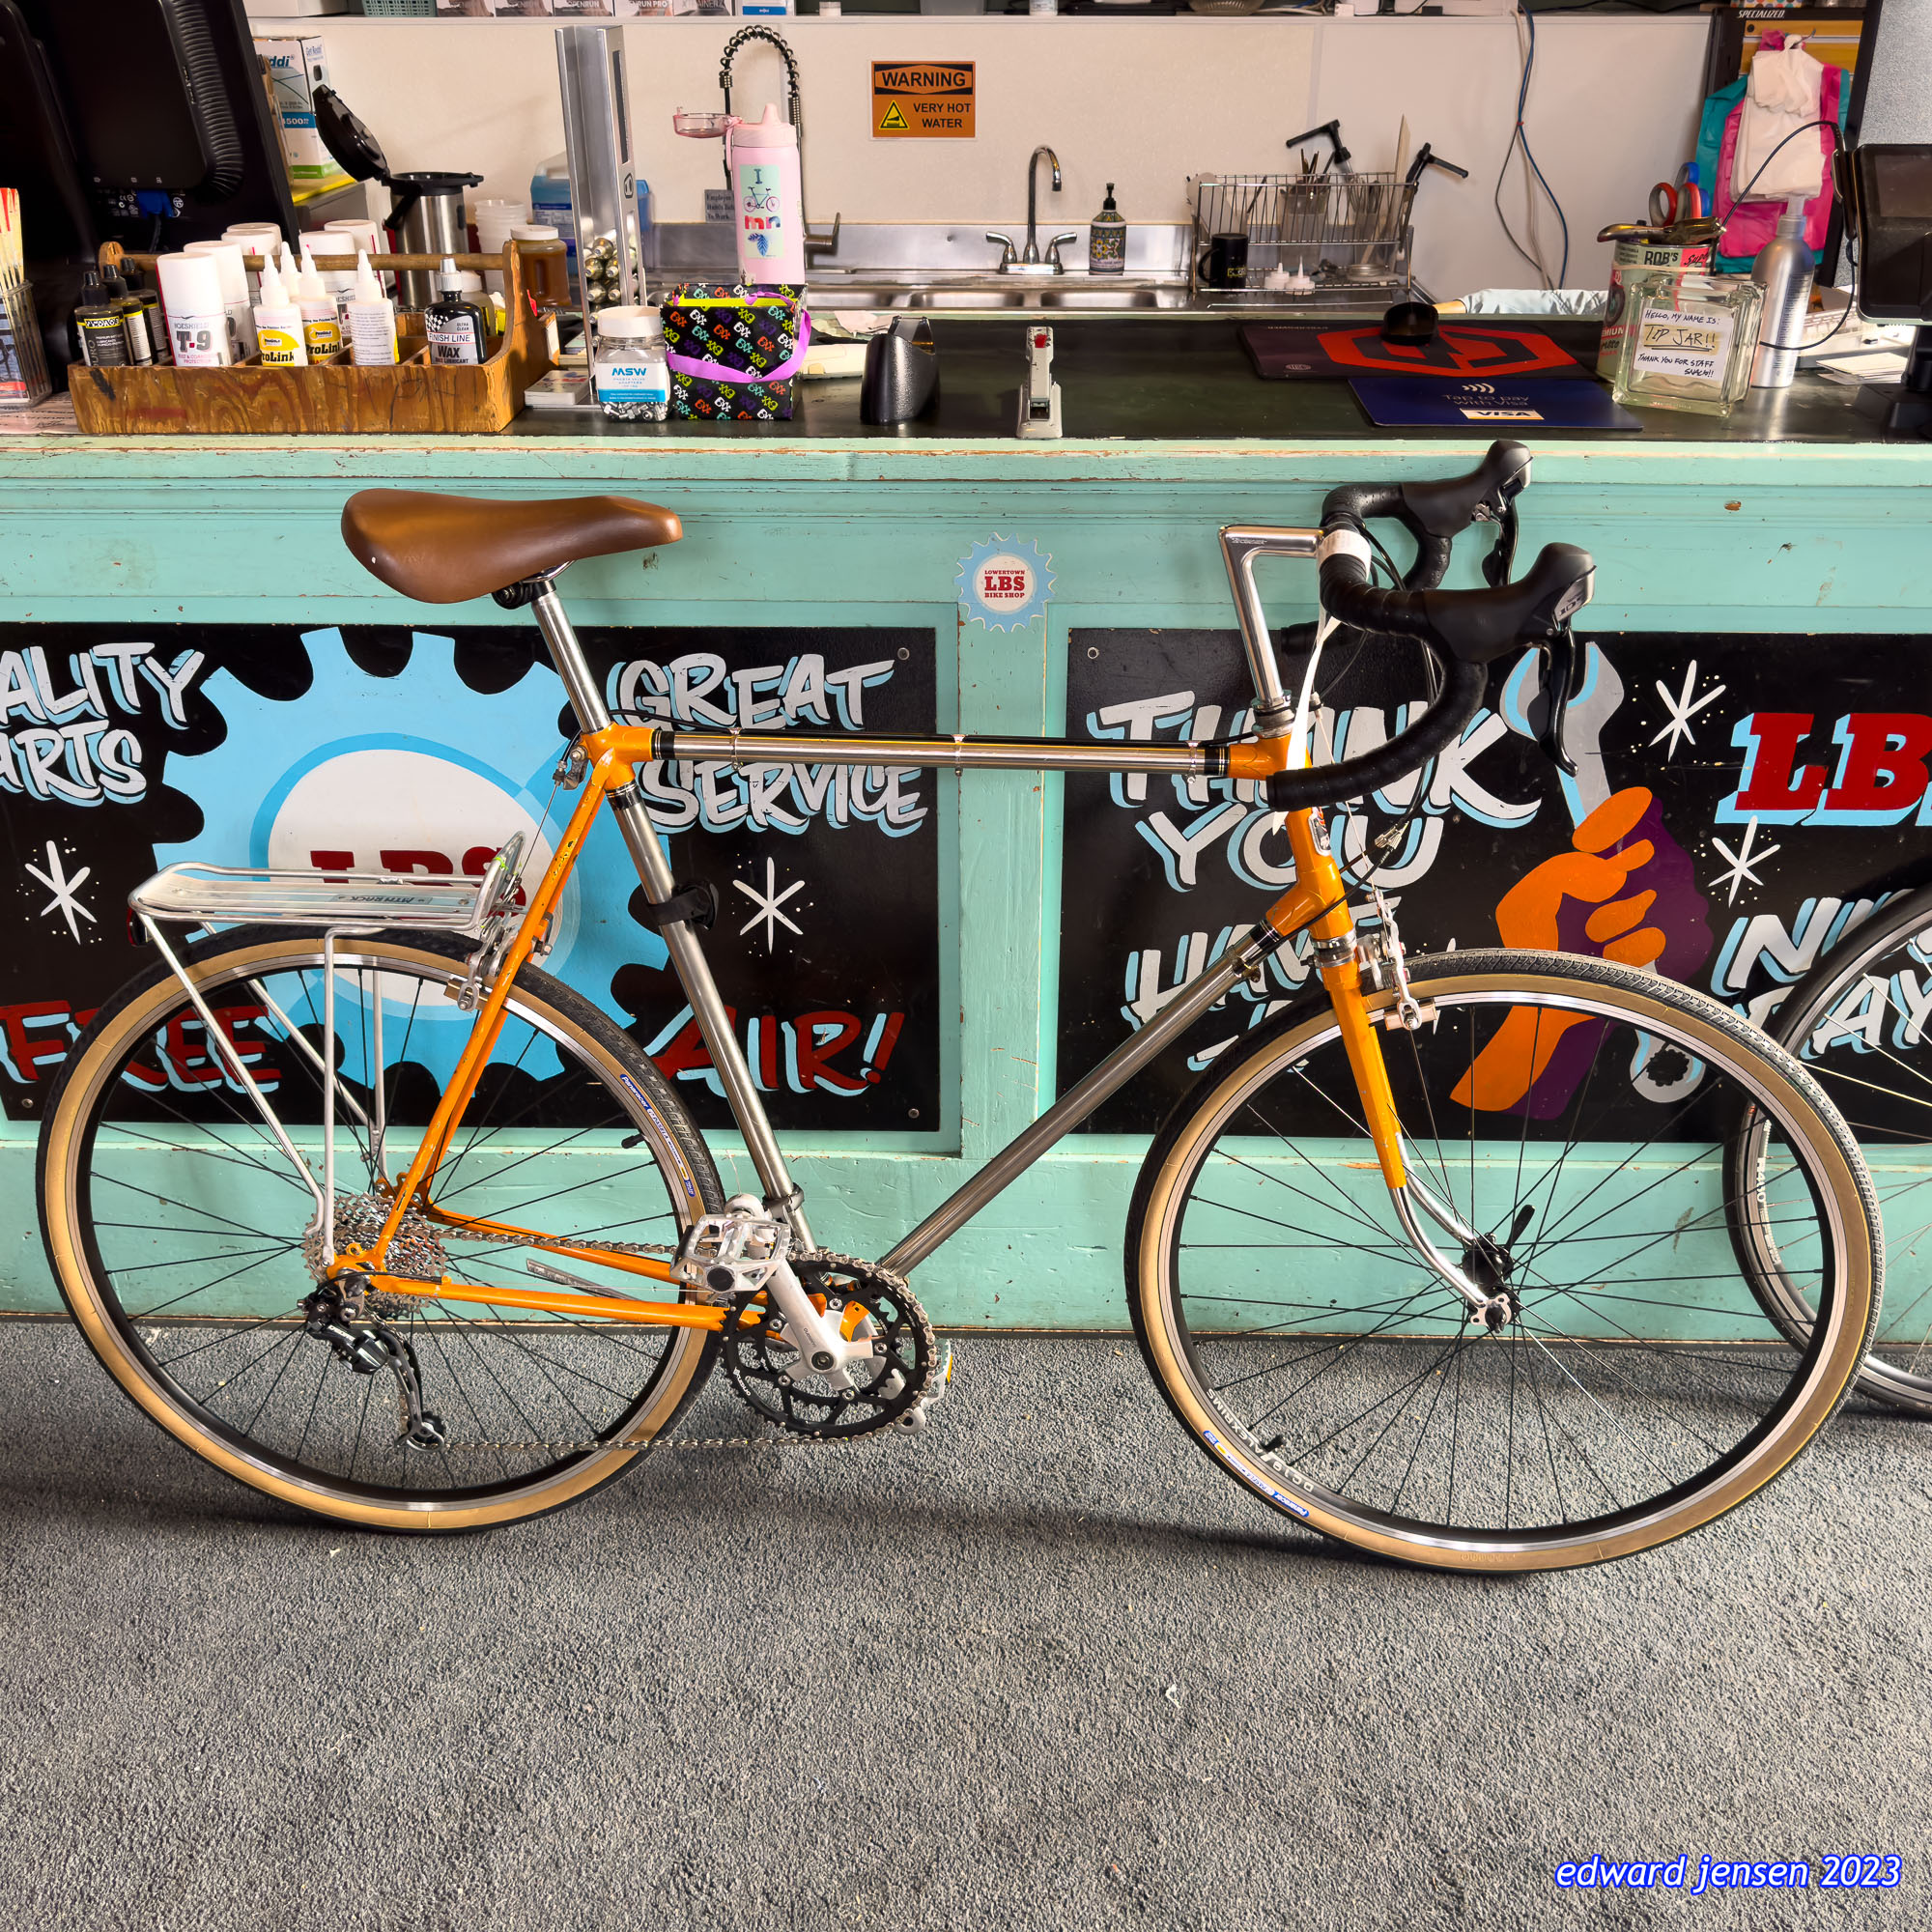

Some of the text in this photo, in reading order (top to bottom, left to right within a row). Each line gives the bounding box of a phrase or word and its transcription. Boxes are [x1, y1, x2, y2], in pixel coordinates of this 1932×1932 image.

[882, 71, 966, 87] WARNING
[913, 102, 971, 113] VERY HOT
[922, 118, 963, 128] WATER
[1670, 312, 1682, 323] MY
[1683, 315, 1704, 324] NAME
[429, 332, 450, 342] FINISH
[1644, 324, 1670, 342] TIP
[438, 345, 461, 358] WAX
[1637, 353, 1660, 363] THANK
[1661, 355, 1673, 364] YOU
[1690, 359, 1715, 368] STAFF
[611, 367, 647, 377] MSW
[984, 576, 1025, 591] LBS
[611, 652, 895, 731] GREAT
[1719, 713, 1932, 823] LB
[635, 760, 928, 836] SERVICE
[647, 1005, 904, 1095] AIR!
